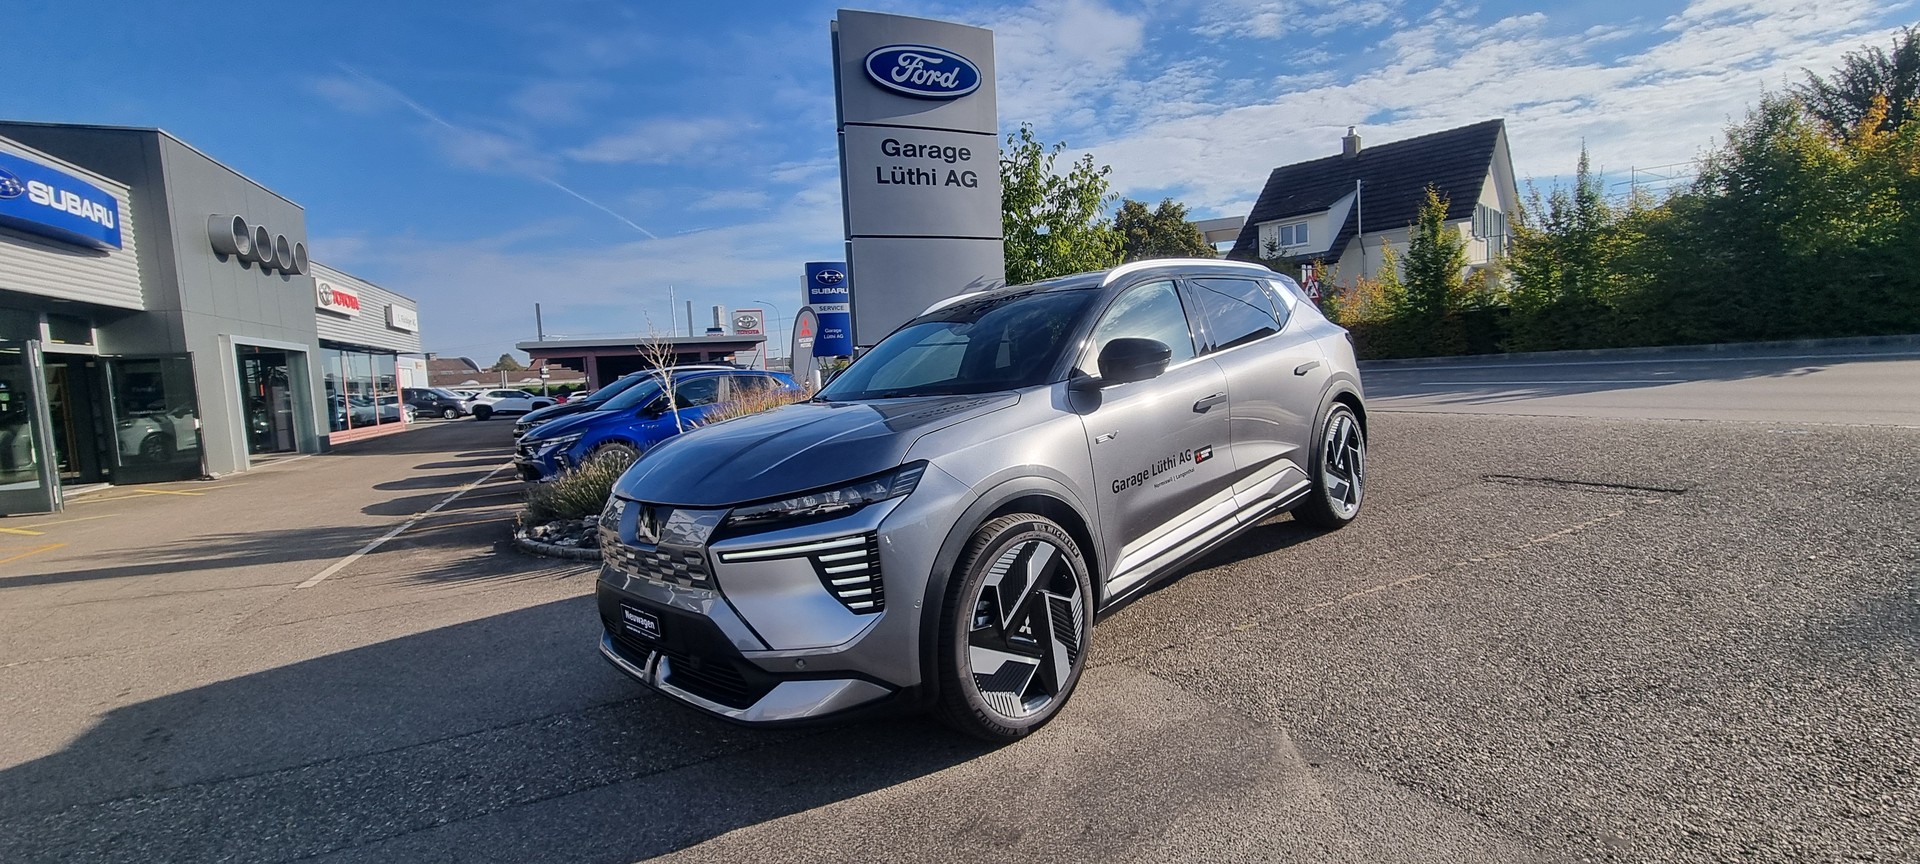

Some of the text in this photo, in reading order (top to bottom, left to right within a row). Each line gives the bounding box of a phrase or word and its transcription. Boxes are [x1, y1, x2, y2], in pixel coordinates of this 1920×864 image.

[891, 52, 960, 89] Ford
[881, 138, 971, 164] Garage
[876, 166, 978, 188] Lüthi AG
[27, 180, 114, 229] SUBARU
[332, 289, 360, 310] TOYOTA
[1112, 469, 1150, 494] Garage
[1151, 455, 1177, 477] Lüthi
[1179, 448, 1192, 465] AG
[1046, 526, 1079, 556] MICHELIN
[625, 609, 656, 630] Neuwagen
